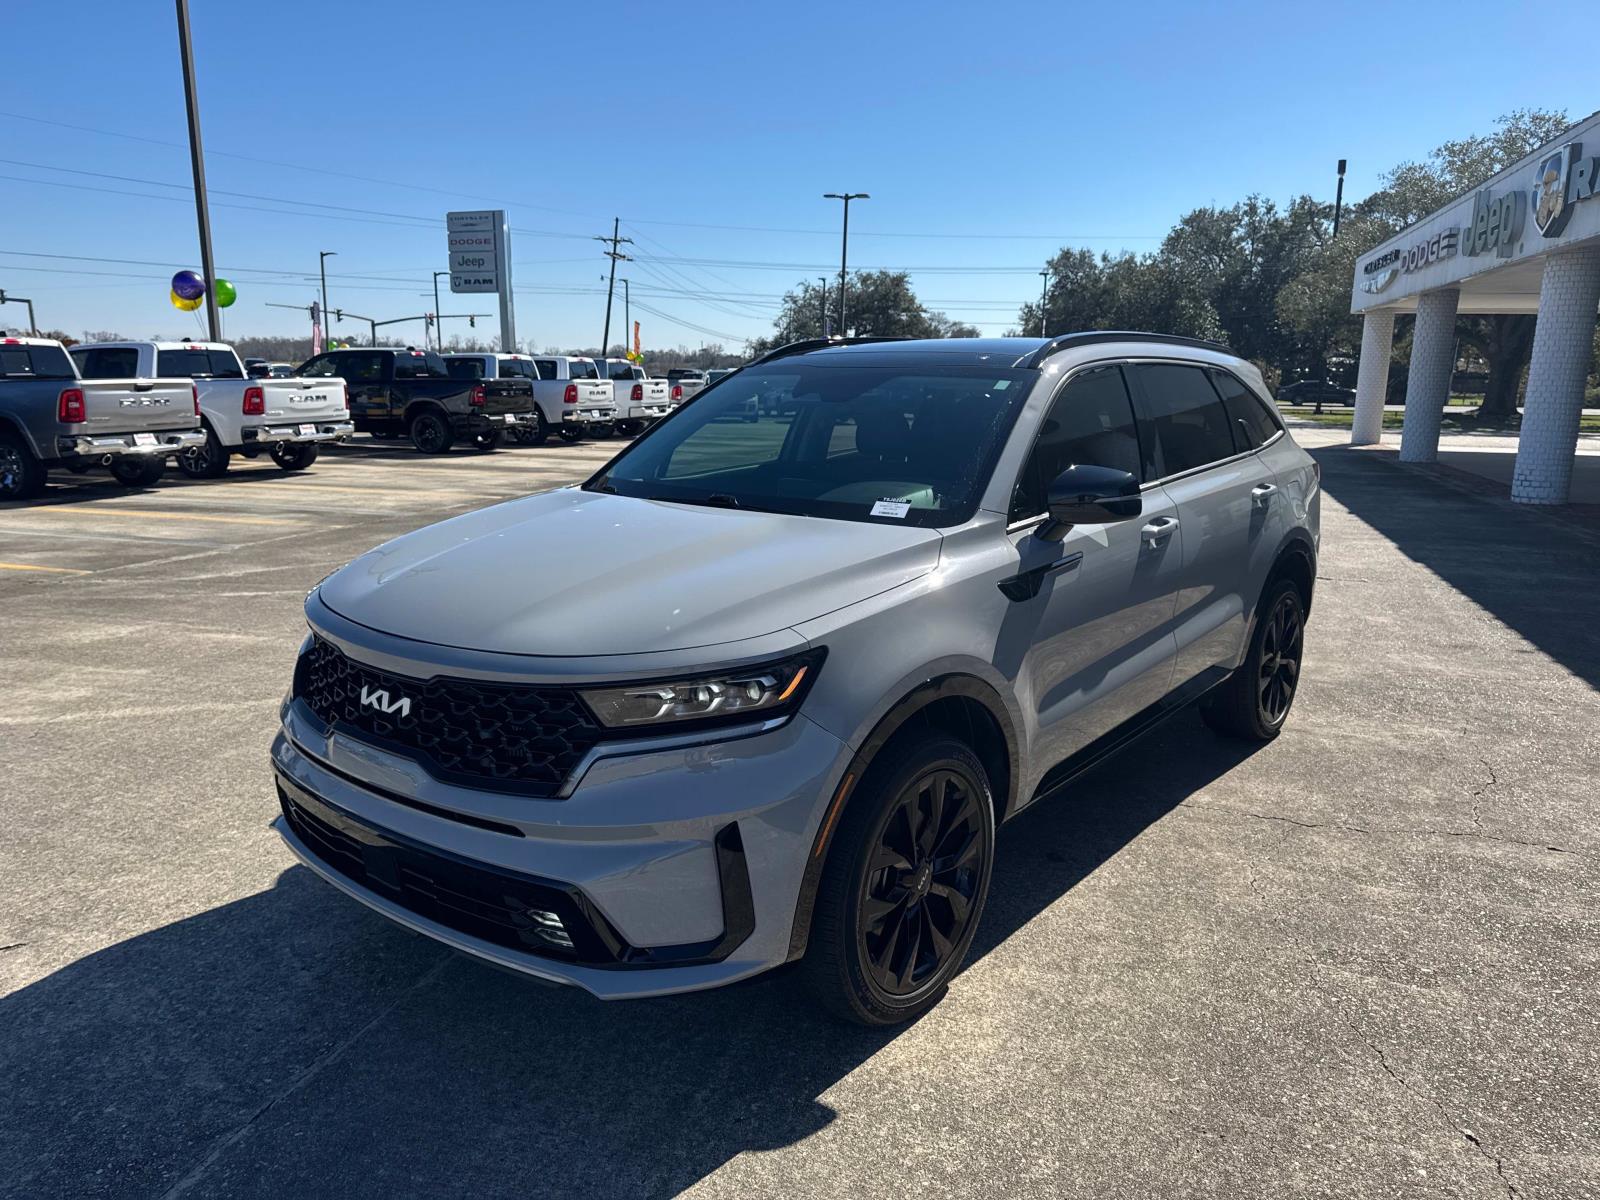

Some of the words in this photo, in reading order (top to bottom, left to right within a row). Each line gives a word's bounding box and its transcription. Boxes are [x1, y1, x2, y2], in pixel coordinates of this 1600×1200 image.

[1568, 156, 1600, 204] R
[1462, 190, 1524, 258] Jeep
[458, 256, 485, 268] Jeep
[1400, 228, 1459, 274] DODGE
[361, 685, 411, 718] KIA
